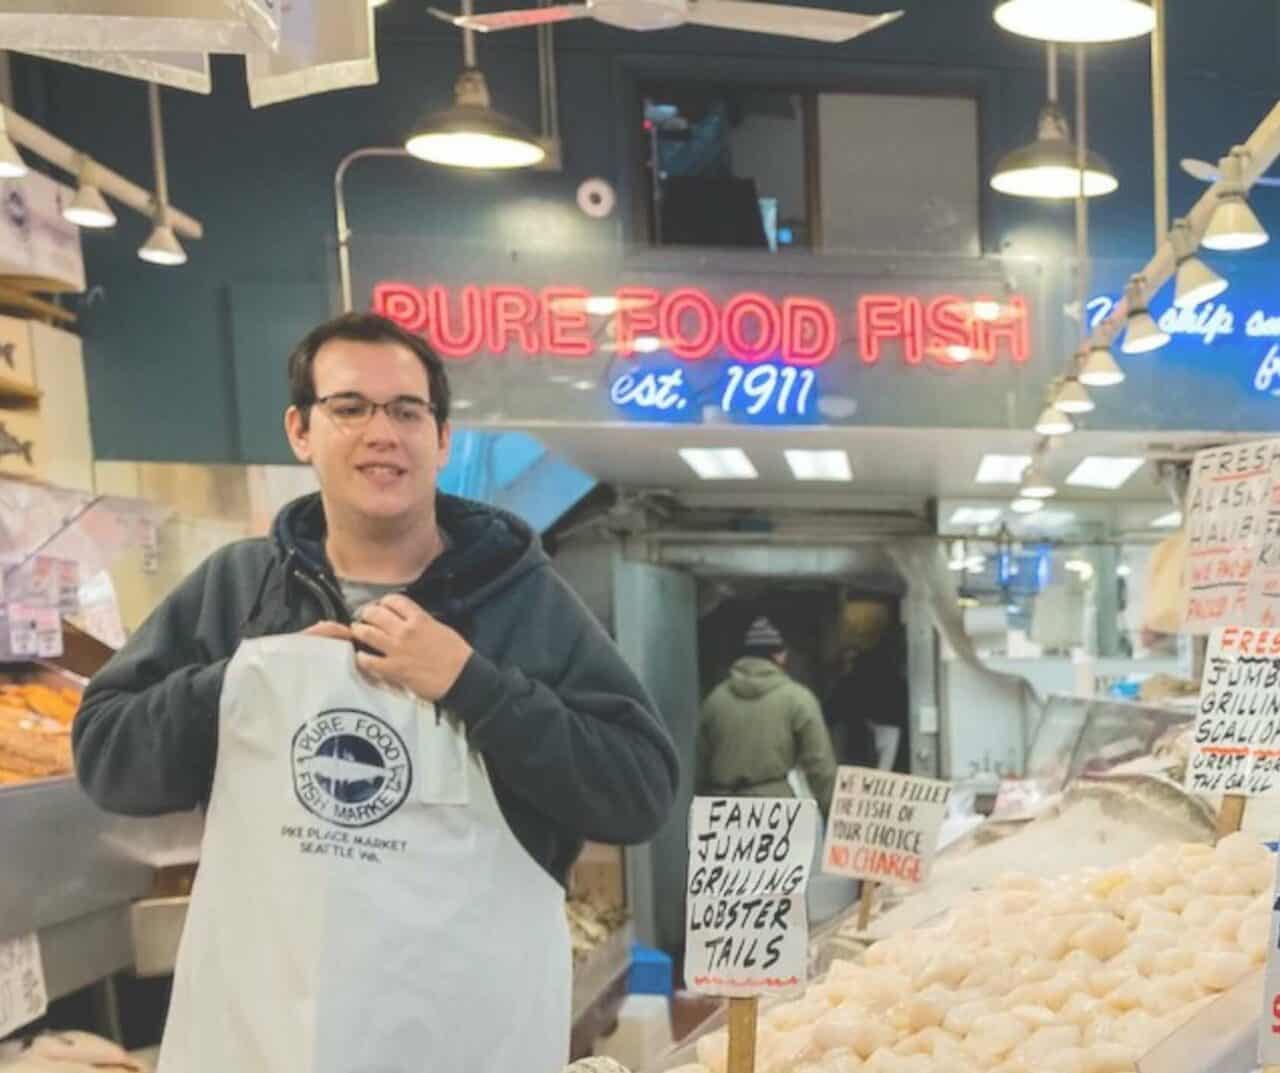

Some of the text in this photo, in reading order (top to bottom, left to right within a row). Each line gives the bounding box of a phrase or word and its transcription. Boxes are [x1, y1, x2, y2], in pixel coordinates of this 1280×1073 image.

[373, 281, 594, 358] PURE
[609, 287, 837, 368] FOOD
[856, 293, 1031, 368] FISH
[610, 364, 817, 417] est. 1911
[300, 716, 400, 761] PURE FOOD
[307, 826, 349, 844] PLACE
[709, 800, 802, 836] FANCY
[301, 841, 353, 859] SEATTLE
[698, 832, 790, 863] JUMBO
[689, 865, 804, 896] GRILLING
[690, 898, 792, 931] LOBSTER
[705, 935, 784, 971] TAILS
